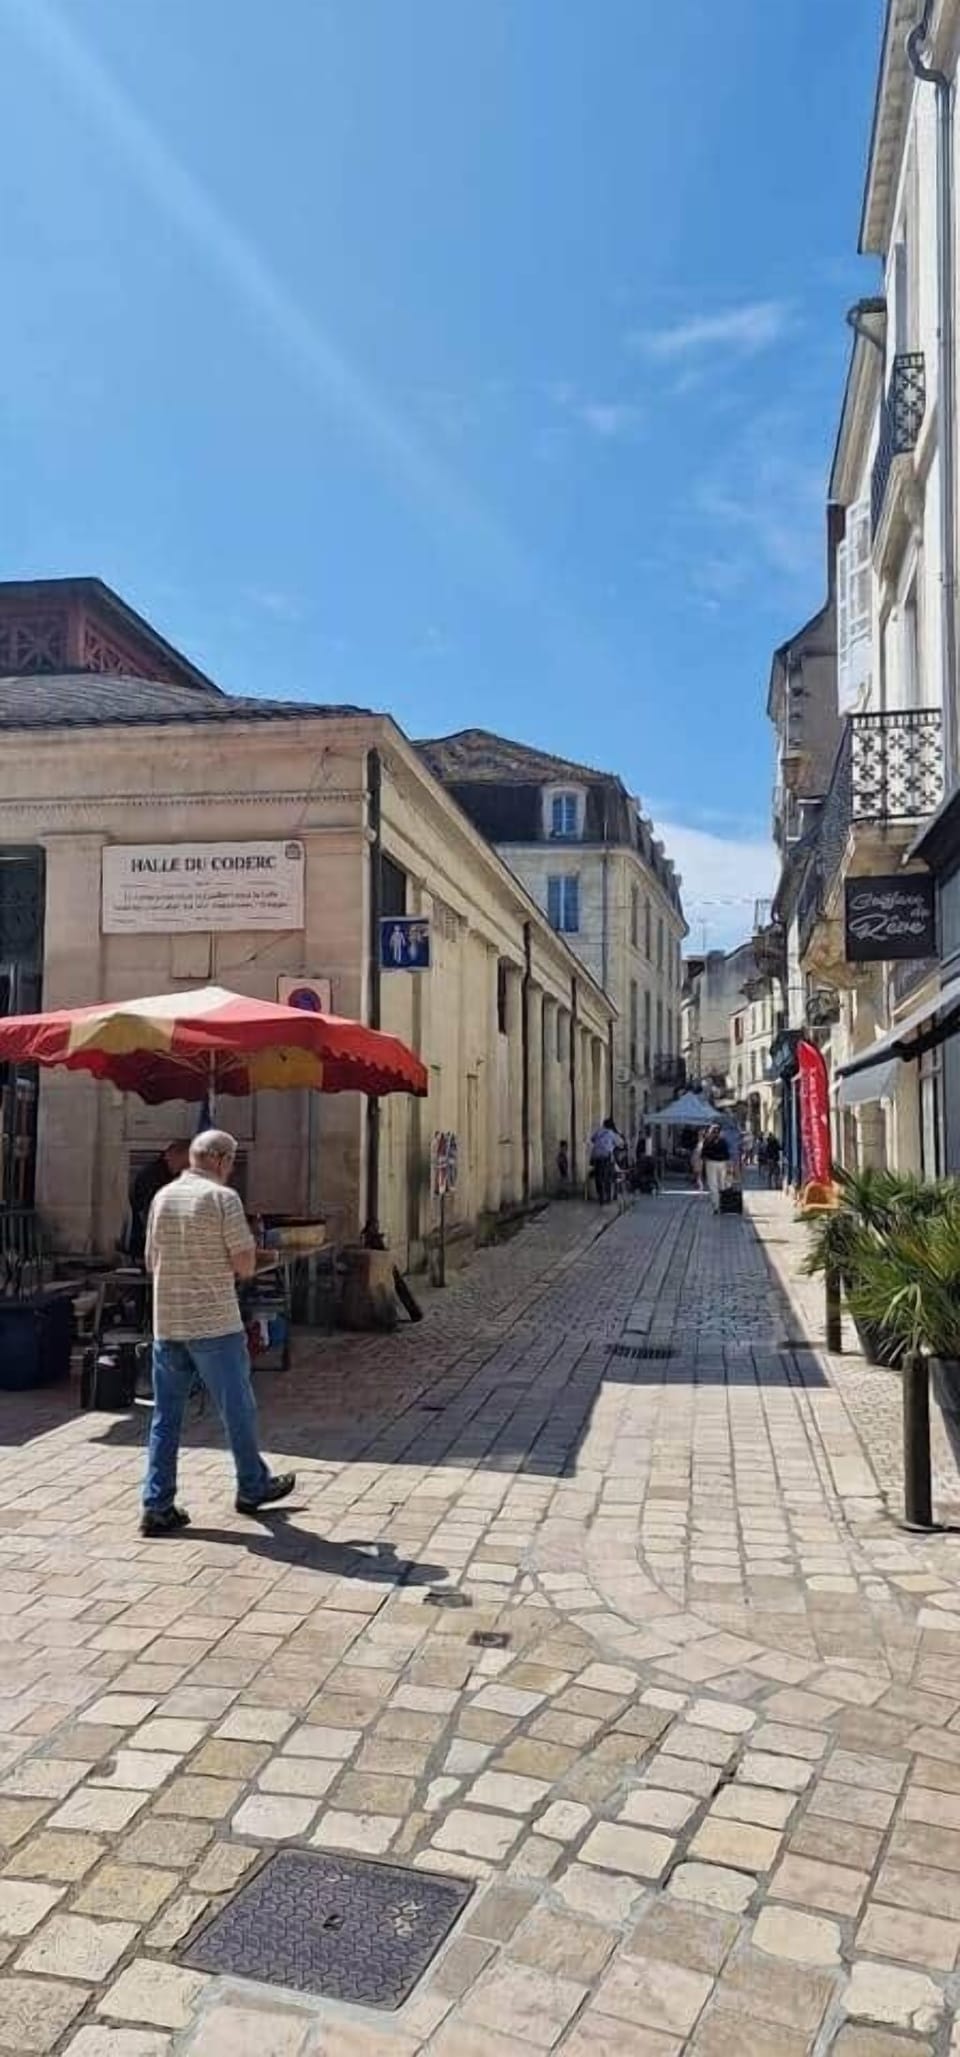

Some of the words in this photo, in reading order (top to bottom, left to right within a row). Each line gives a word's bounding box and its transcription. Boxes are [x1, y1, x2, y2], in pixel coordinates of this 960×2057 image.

[131, 857, 180, 873] HALLE
[184, 857, 207, 872] DU
[211, 855, 277, 871] CODERC
